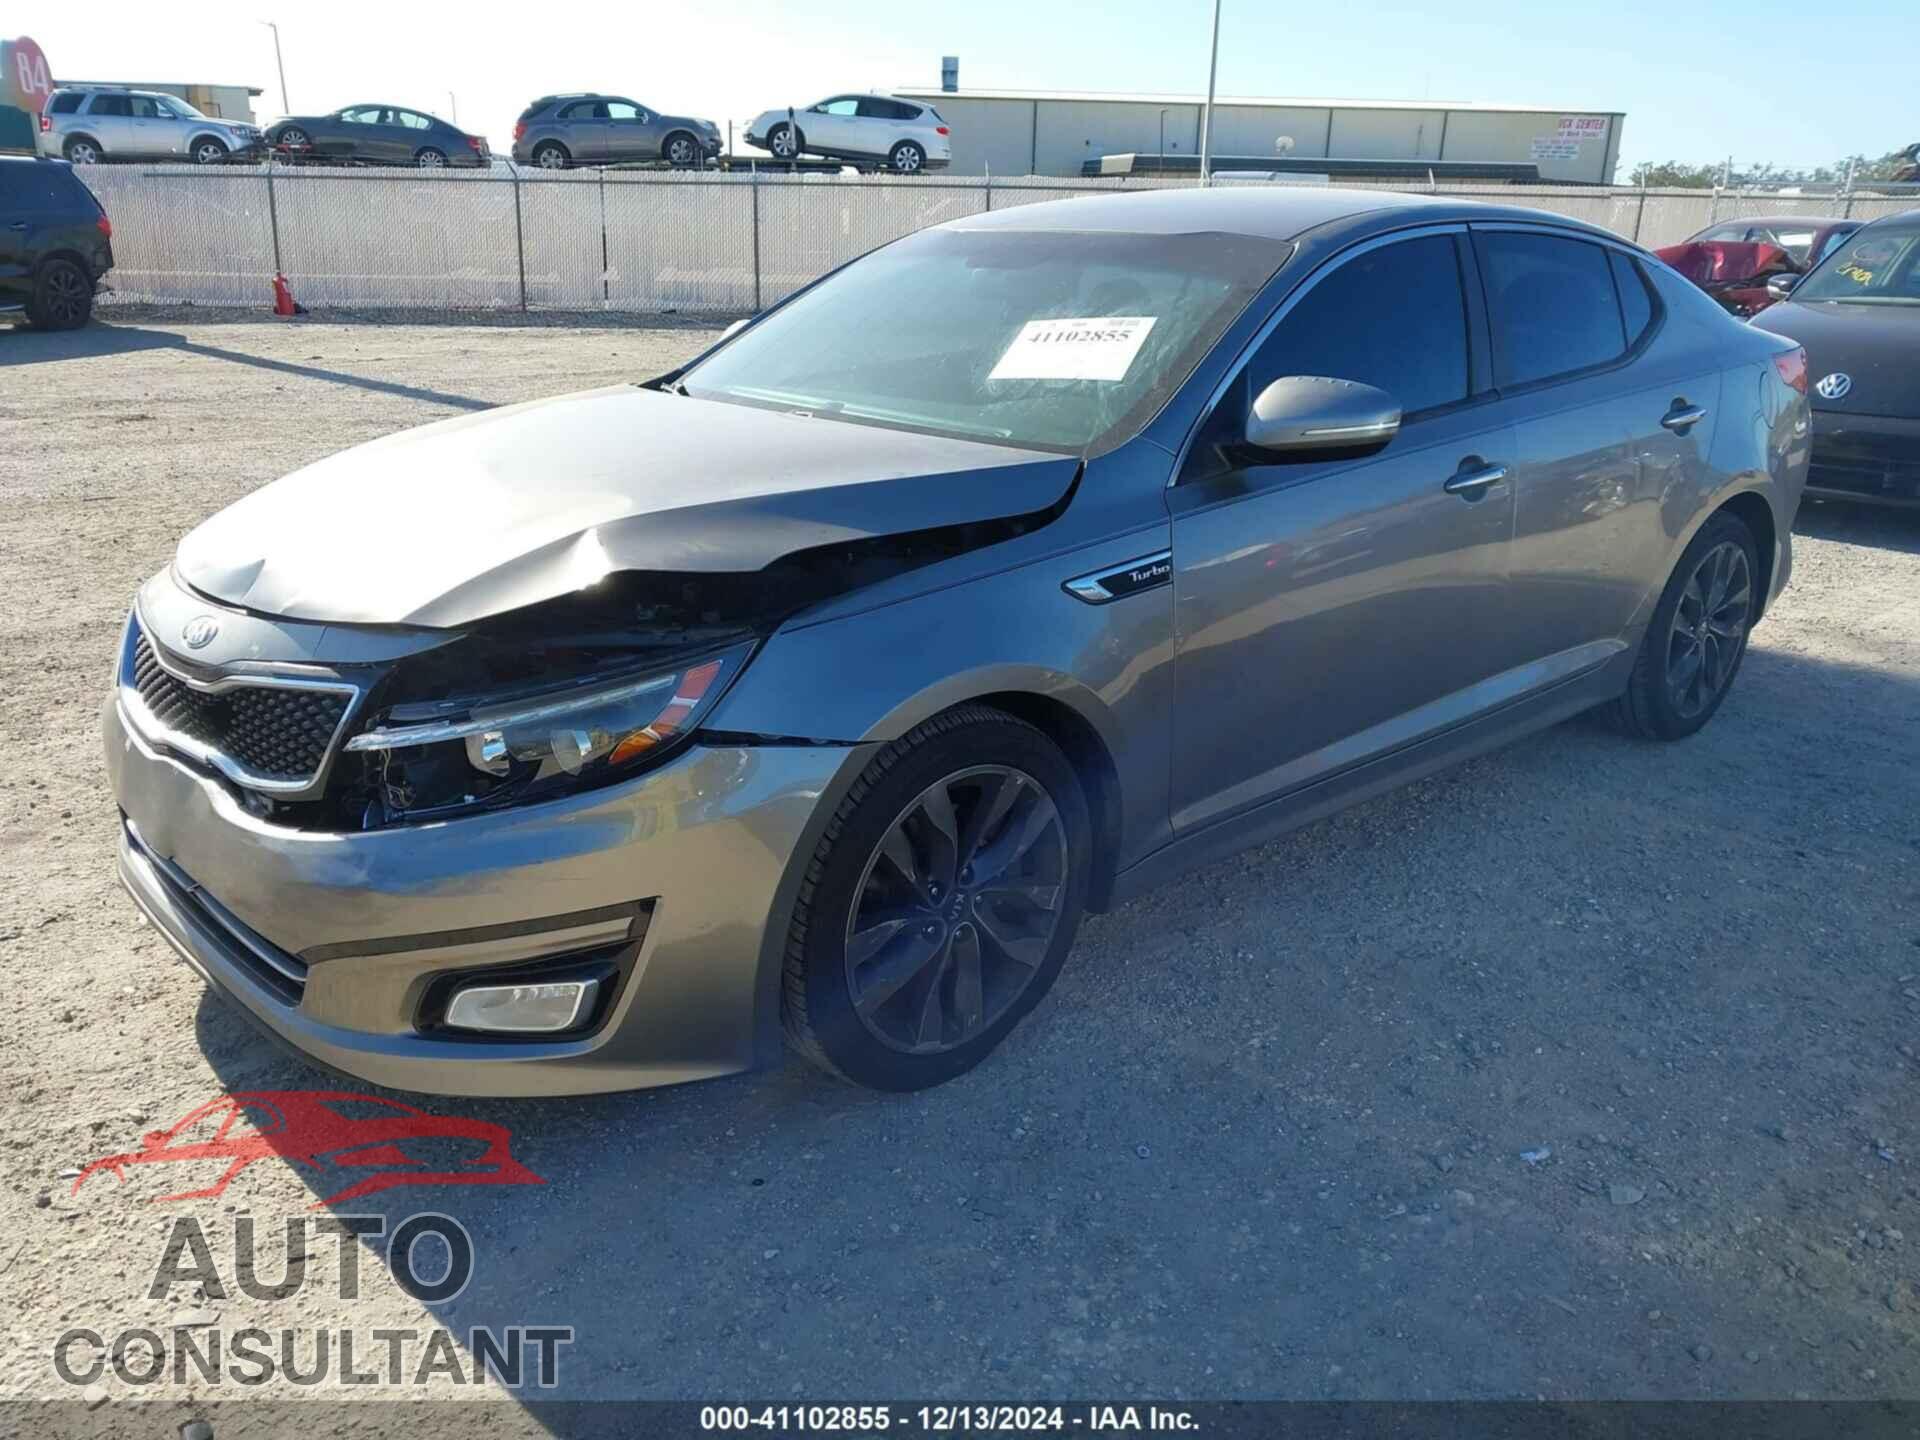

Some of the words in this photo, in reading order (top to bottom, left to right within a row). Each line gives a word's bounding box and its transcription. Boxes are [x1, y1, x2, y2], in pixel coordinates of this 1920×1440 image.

[16, 52, 49, 96] 84
[1028, 329, 1133, 344] 41102855
[1128, 564, 1170, 582] Turbo
